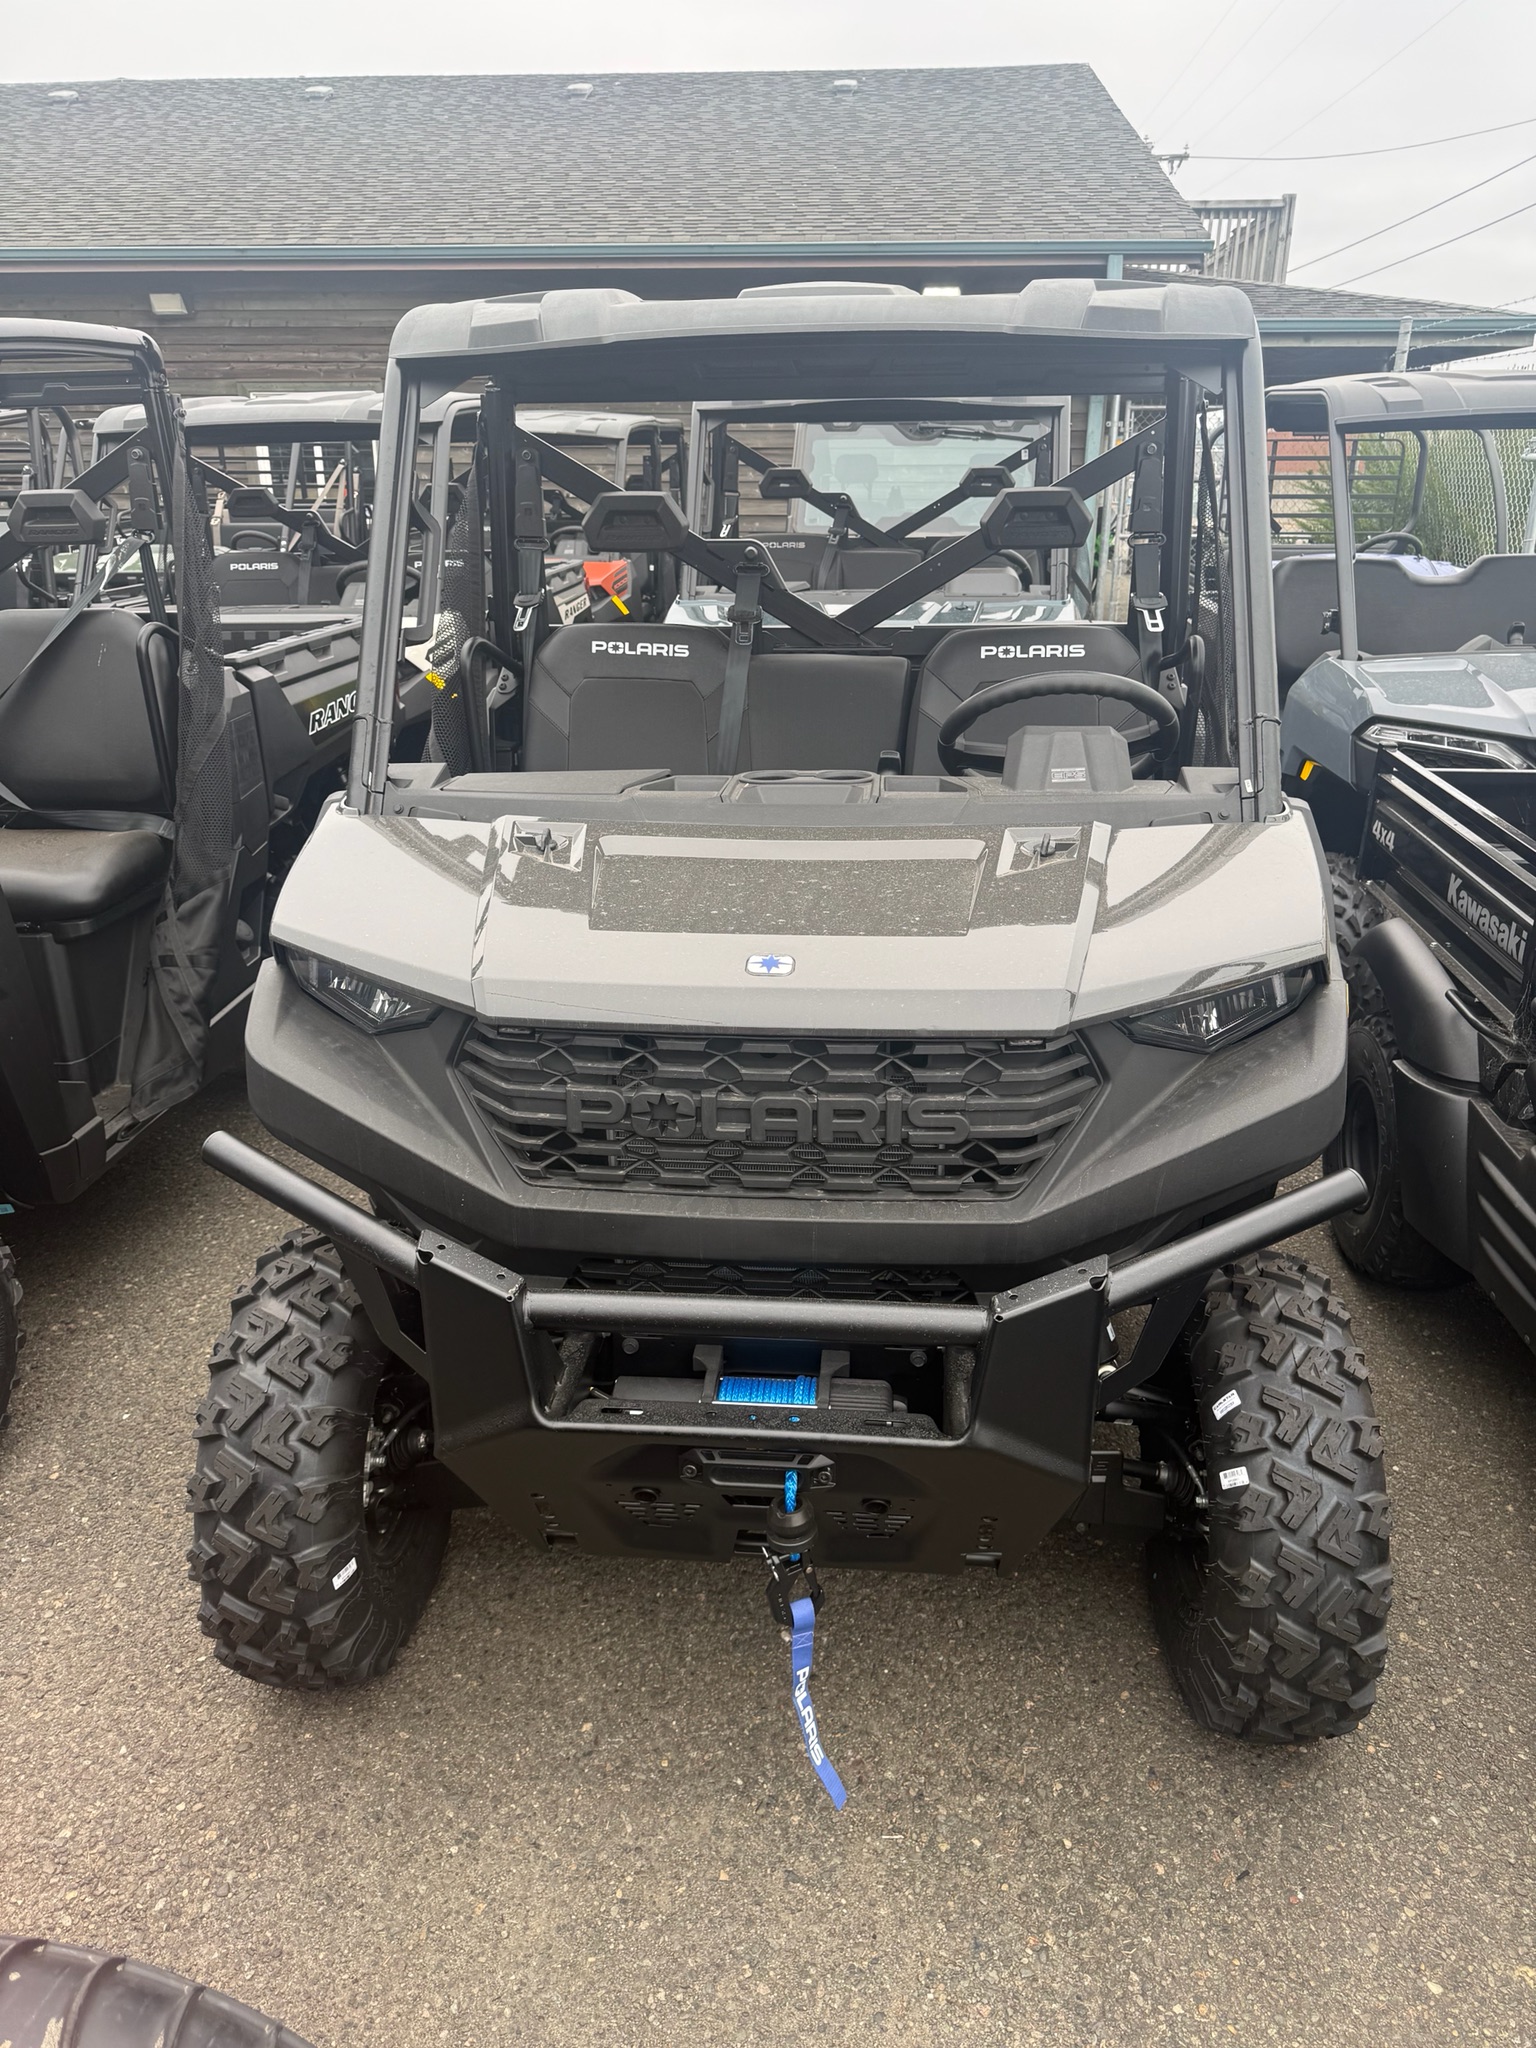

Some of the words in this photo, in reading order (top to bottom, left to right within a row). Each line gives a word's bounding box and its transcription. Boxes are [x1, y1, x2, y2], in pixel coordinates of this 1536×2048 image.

[229, 562, 279, 571] POLARIS
[564, 597, 588, 621] RANGER
[591, 640, 690, 658] POLARIS
[980, 644, 1086, 659] POLARIS
[1371, 819, 1396, 852] 4x4
[1446, 872, 1528, 965] Kawasaki
[566, 1083, 971, 1145] POLARIS
[794, 1665, 825, 1767] POLARIS
